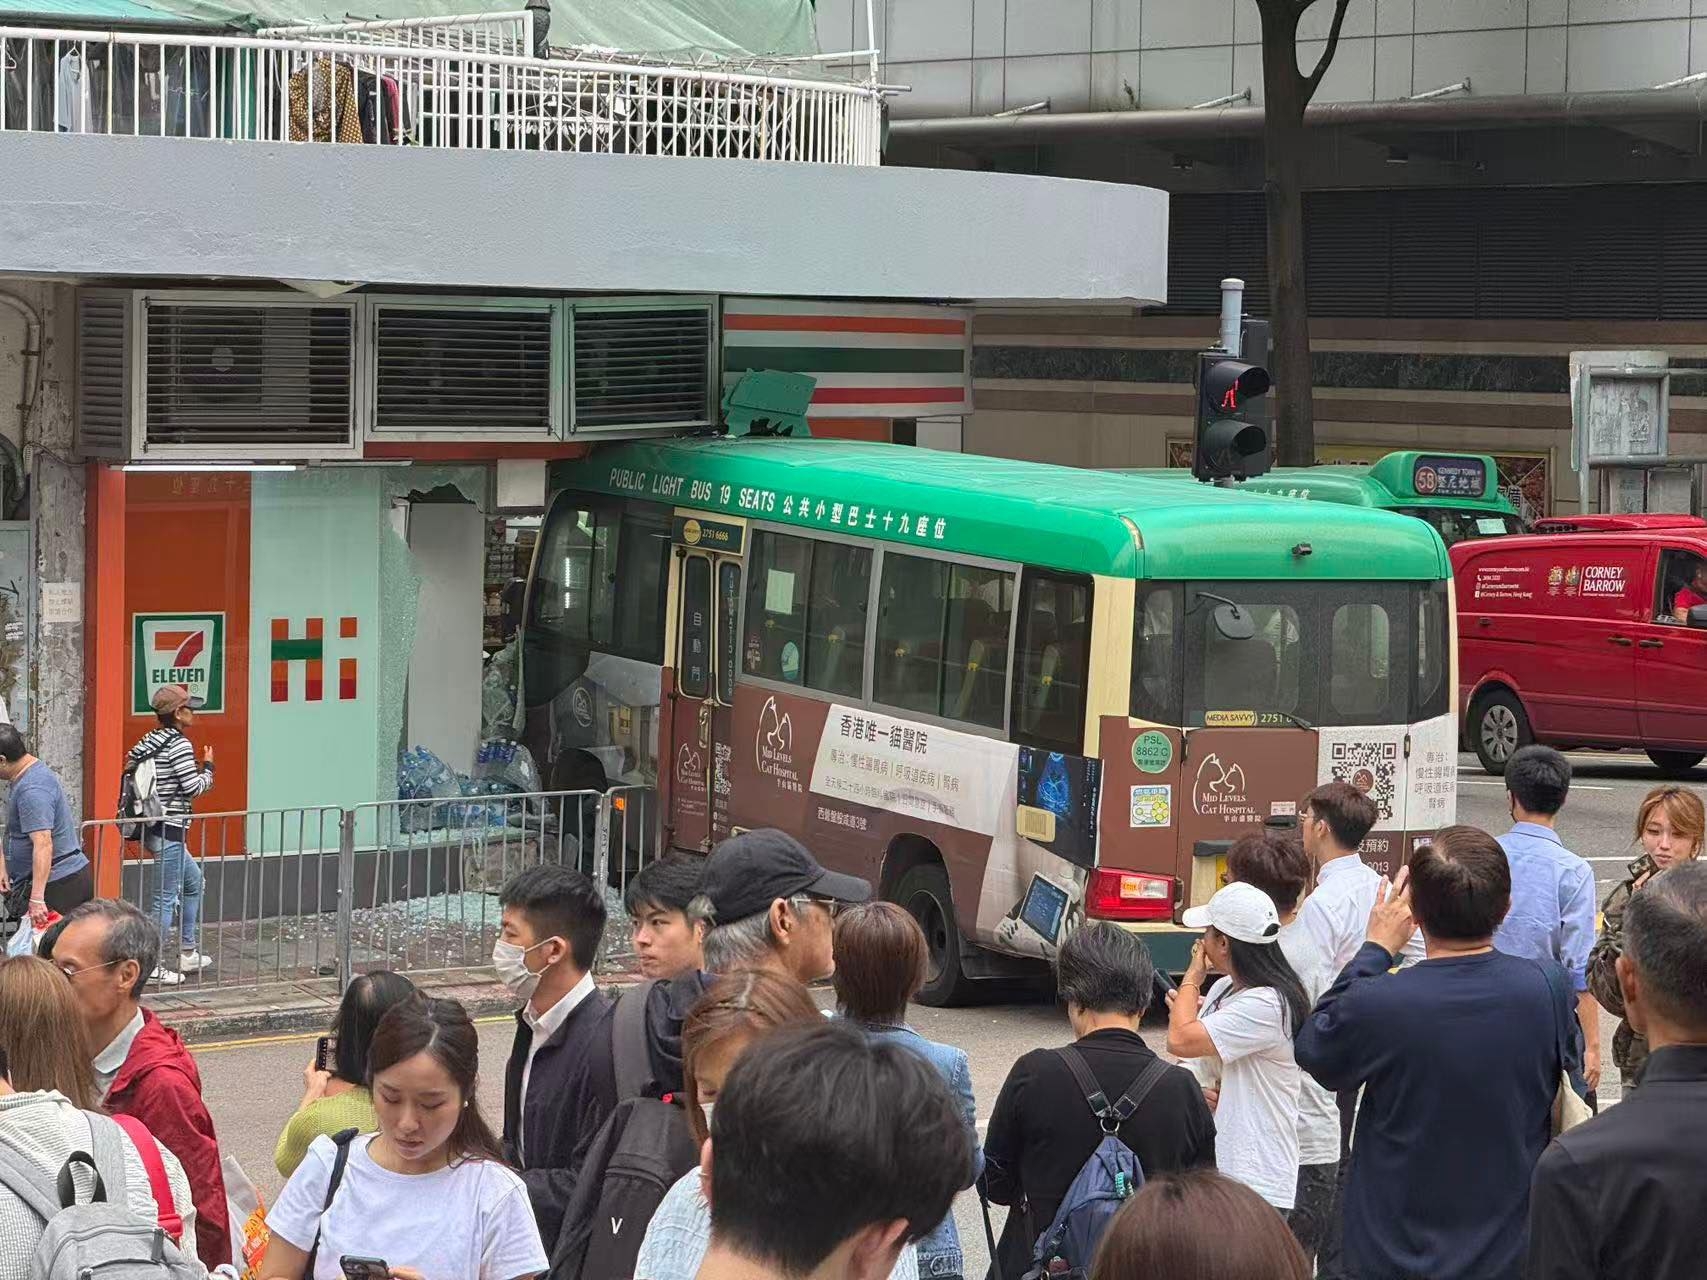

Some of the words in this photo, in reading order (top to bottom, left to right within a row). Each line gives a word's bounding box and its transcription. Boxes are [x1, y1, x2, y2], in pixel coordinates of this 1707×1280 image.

[609, 468, 645, 491] PUBLIC
[652, 474, 684, 497] LIGHT
[691, 480, 711, 501] BUS
[720, 484, 731, 504] 19
[739, 488, 775, 512] SEATS
[783, 494, 947, 540] 公共小型巴士十九座位
[1585, 566, 1623, 579] CORNEY
[1583, 579, 1625, 592] BARROW
[691, 611, 703, 681] 自動門
[270, 616, 358, 702] Hi
[1207, 713, 1230, 721] MEDIA
[1230, 713, 1254, 721] SAVVY
[1260, 713, 1283, 723] 2751
[840, 714, 928, 755] 香港唯一貓醫院
[1143, 735, 1162, 745] PSL
[762, 745, 773, 759] MID
[773, 747, 792, 763] LEVELS
[1161, 747, 1169, 756] C
[761, 760, 773, 774] CAT
[773, 762, 799, 781] HOSPITAL
[1202, 793, 1218, 802] MID
[1219, 793, 1247, 802] LEVELS
[1201, 804, 1218, 815] CAT
[1219, 803, 1256, 814] HOSPITAL
